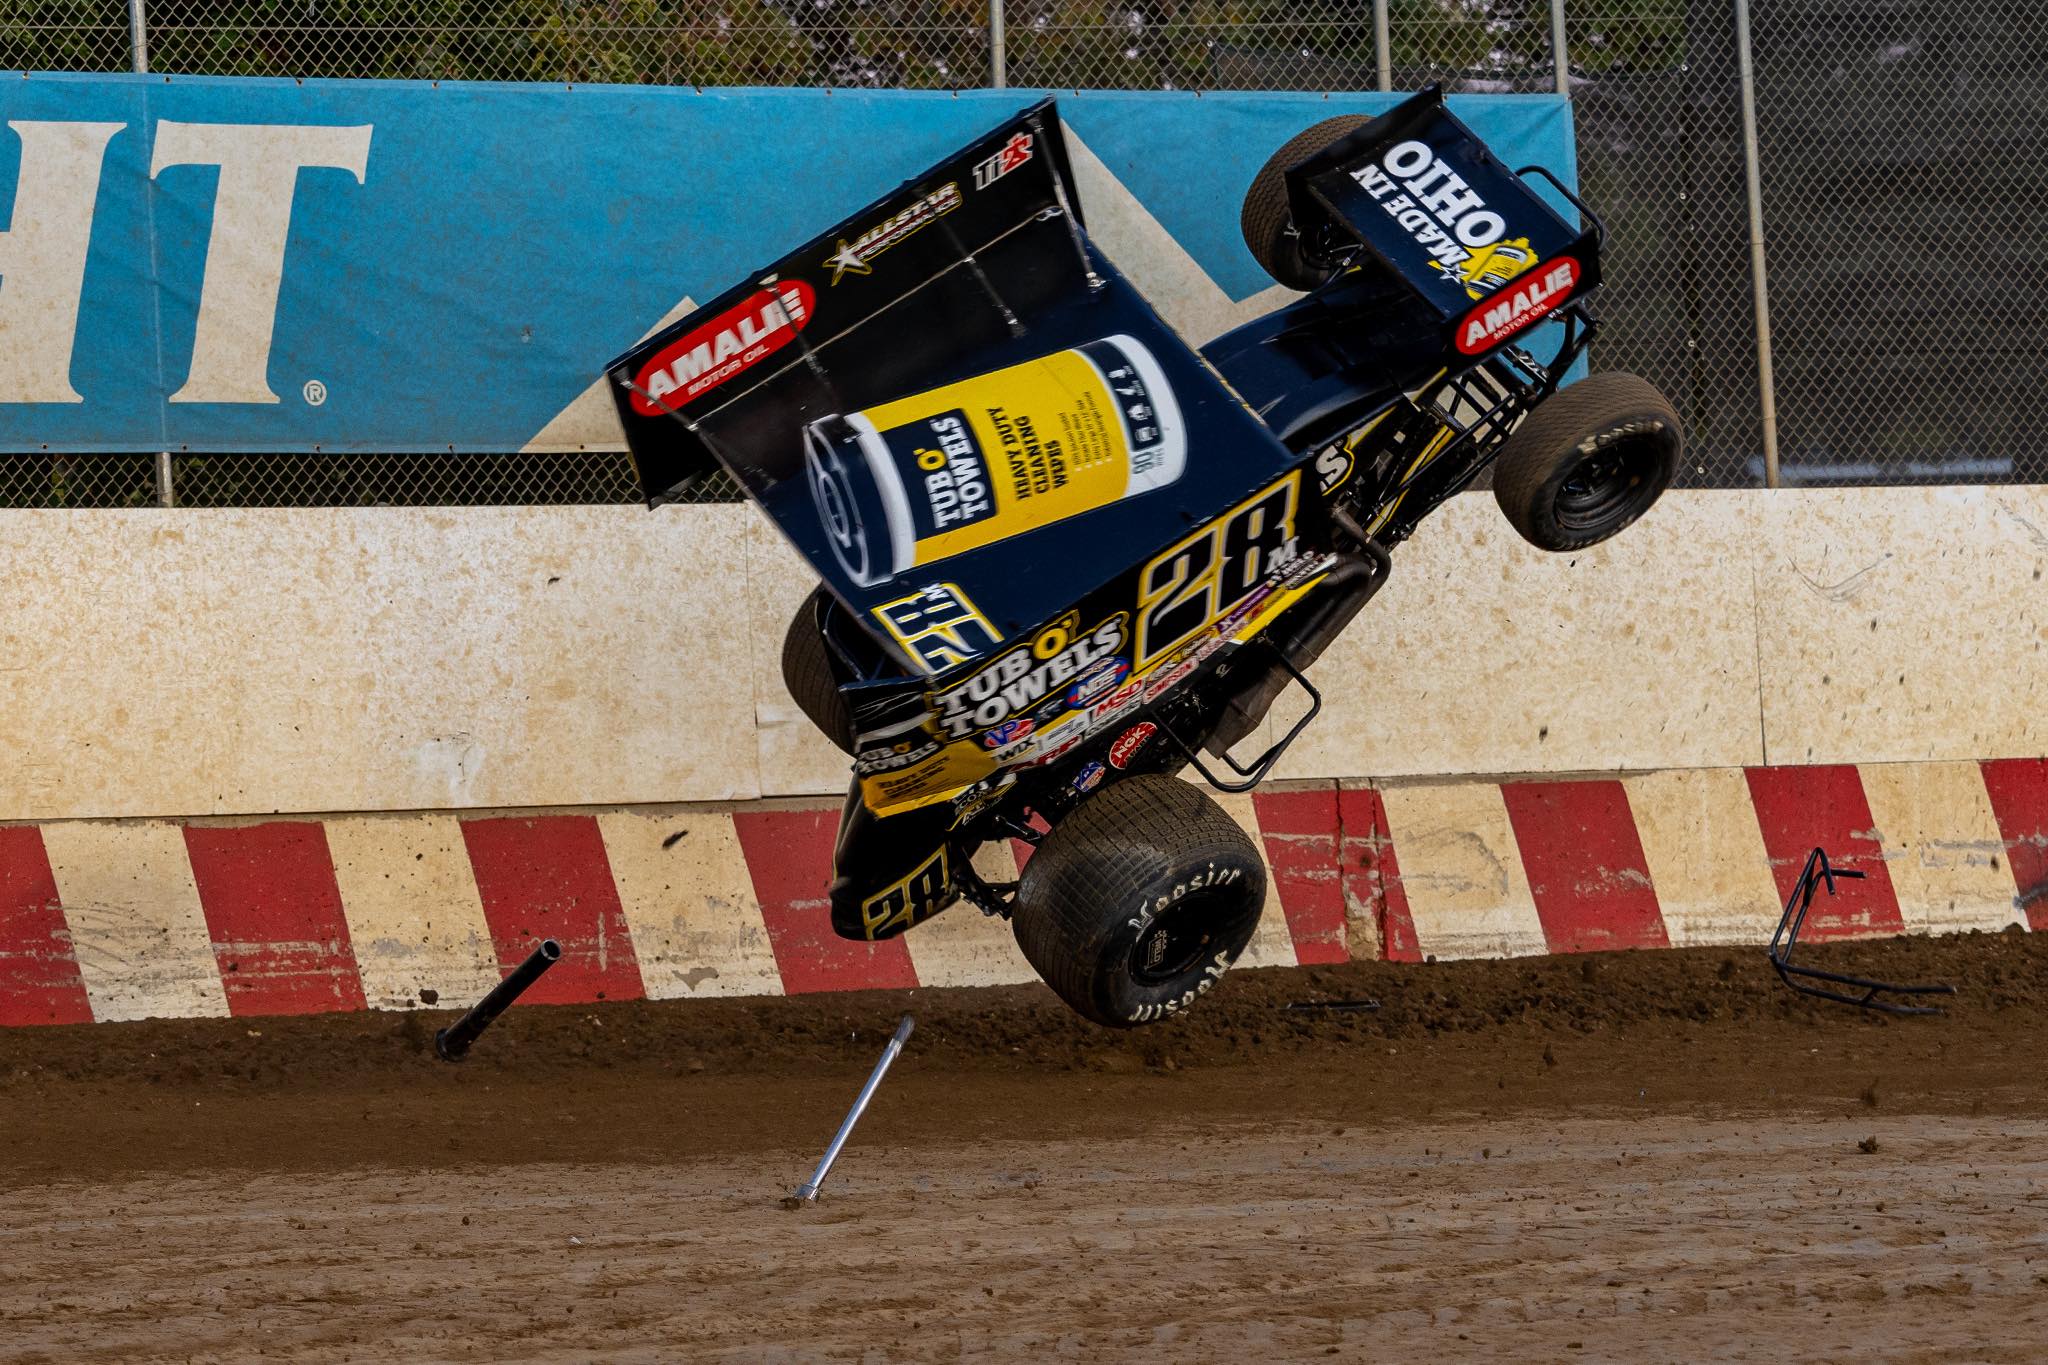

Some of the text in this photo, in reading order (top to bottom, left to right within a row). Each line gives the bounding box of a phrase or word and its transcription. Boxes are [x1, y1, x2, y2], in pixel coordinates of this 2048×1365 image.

[1349, 163, 1470, 267] MADE IN
[1383, 139, 1507, 248] OHIO
[647, 287, 805, 407] AMALIE
[1465, 262, 1574, 348] AMALIE
[1493, 302, 1549, 341] MOTOR OIL
[687, 344, 770, 396] MOTOR OIL
[930, 416, 990, 521] TOWELS
[986, 406, 1033, 501] HEAVY DUTY
[1013, 415, 1051, 495] CLEANING
[1044, 439, 1069, 490] WIPES
[924, 469, 963, 529] TUB
[933, 648, 1032, 717] TUB
[940, 619, 1123, 738] TOWELS
[1114, 727, 1147, 759] NGK
[861, 842, 950, 941] 28
